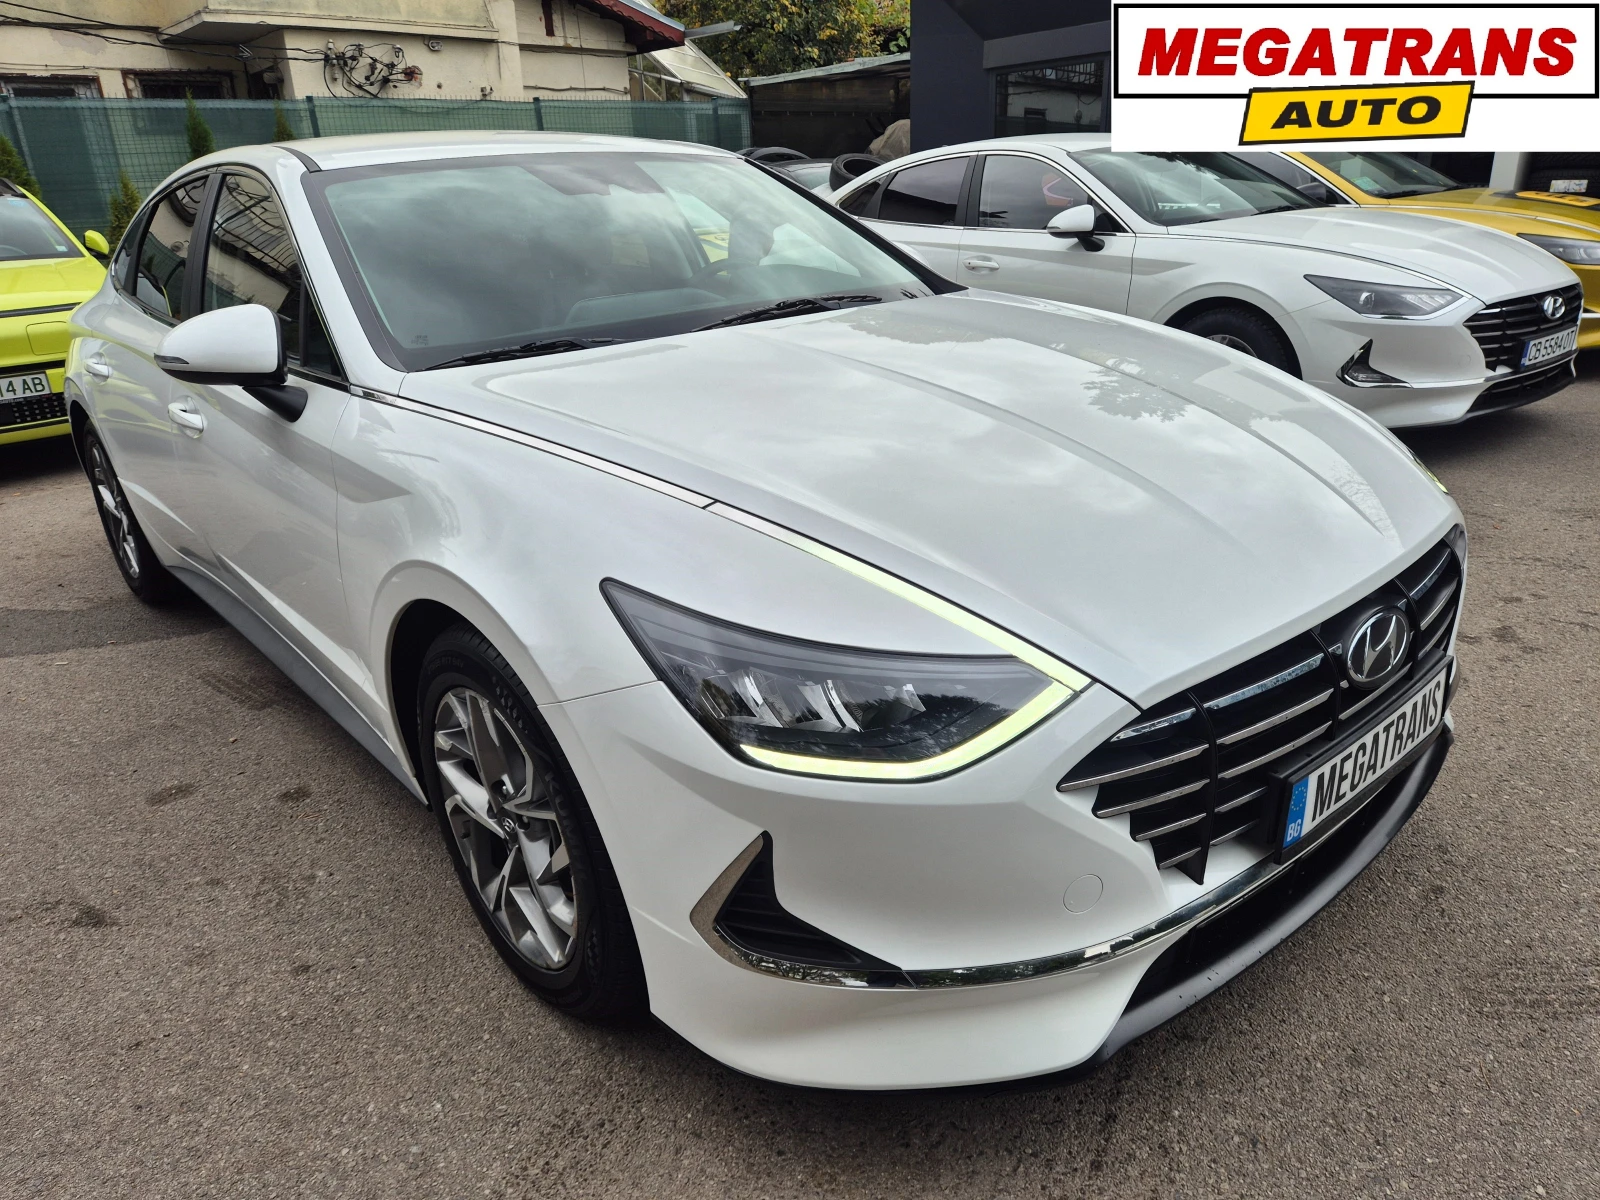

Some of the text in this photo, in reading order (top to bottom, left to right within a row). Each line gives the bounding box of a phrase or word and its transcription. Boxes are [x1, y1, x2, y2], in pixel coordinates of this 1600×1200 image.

[22, 376, 46, 394] AB
[1311, 679, 1441, 823] MEGATRANS
[1287, 819, 1302, 842] BG
